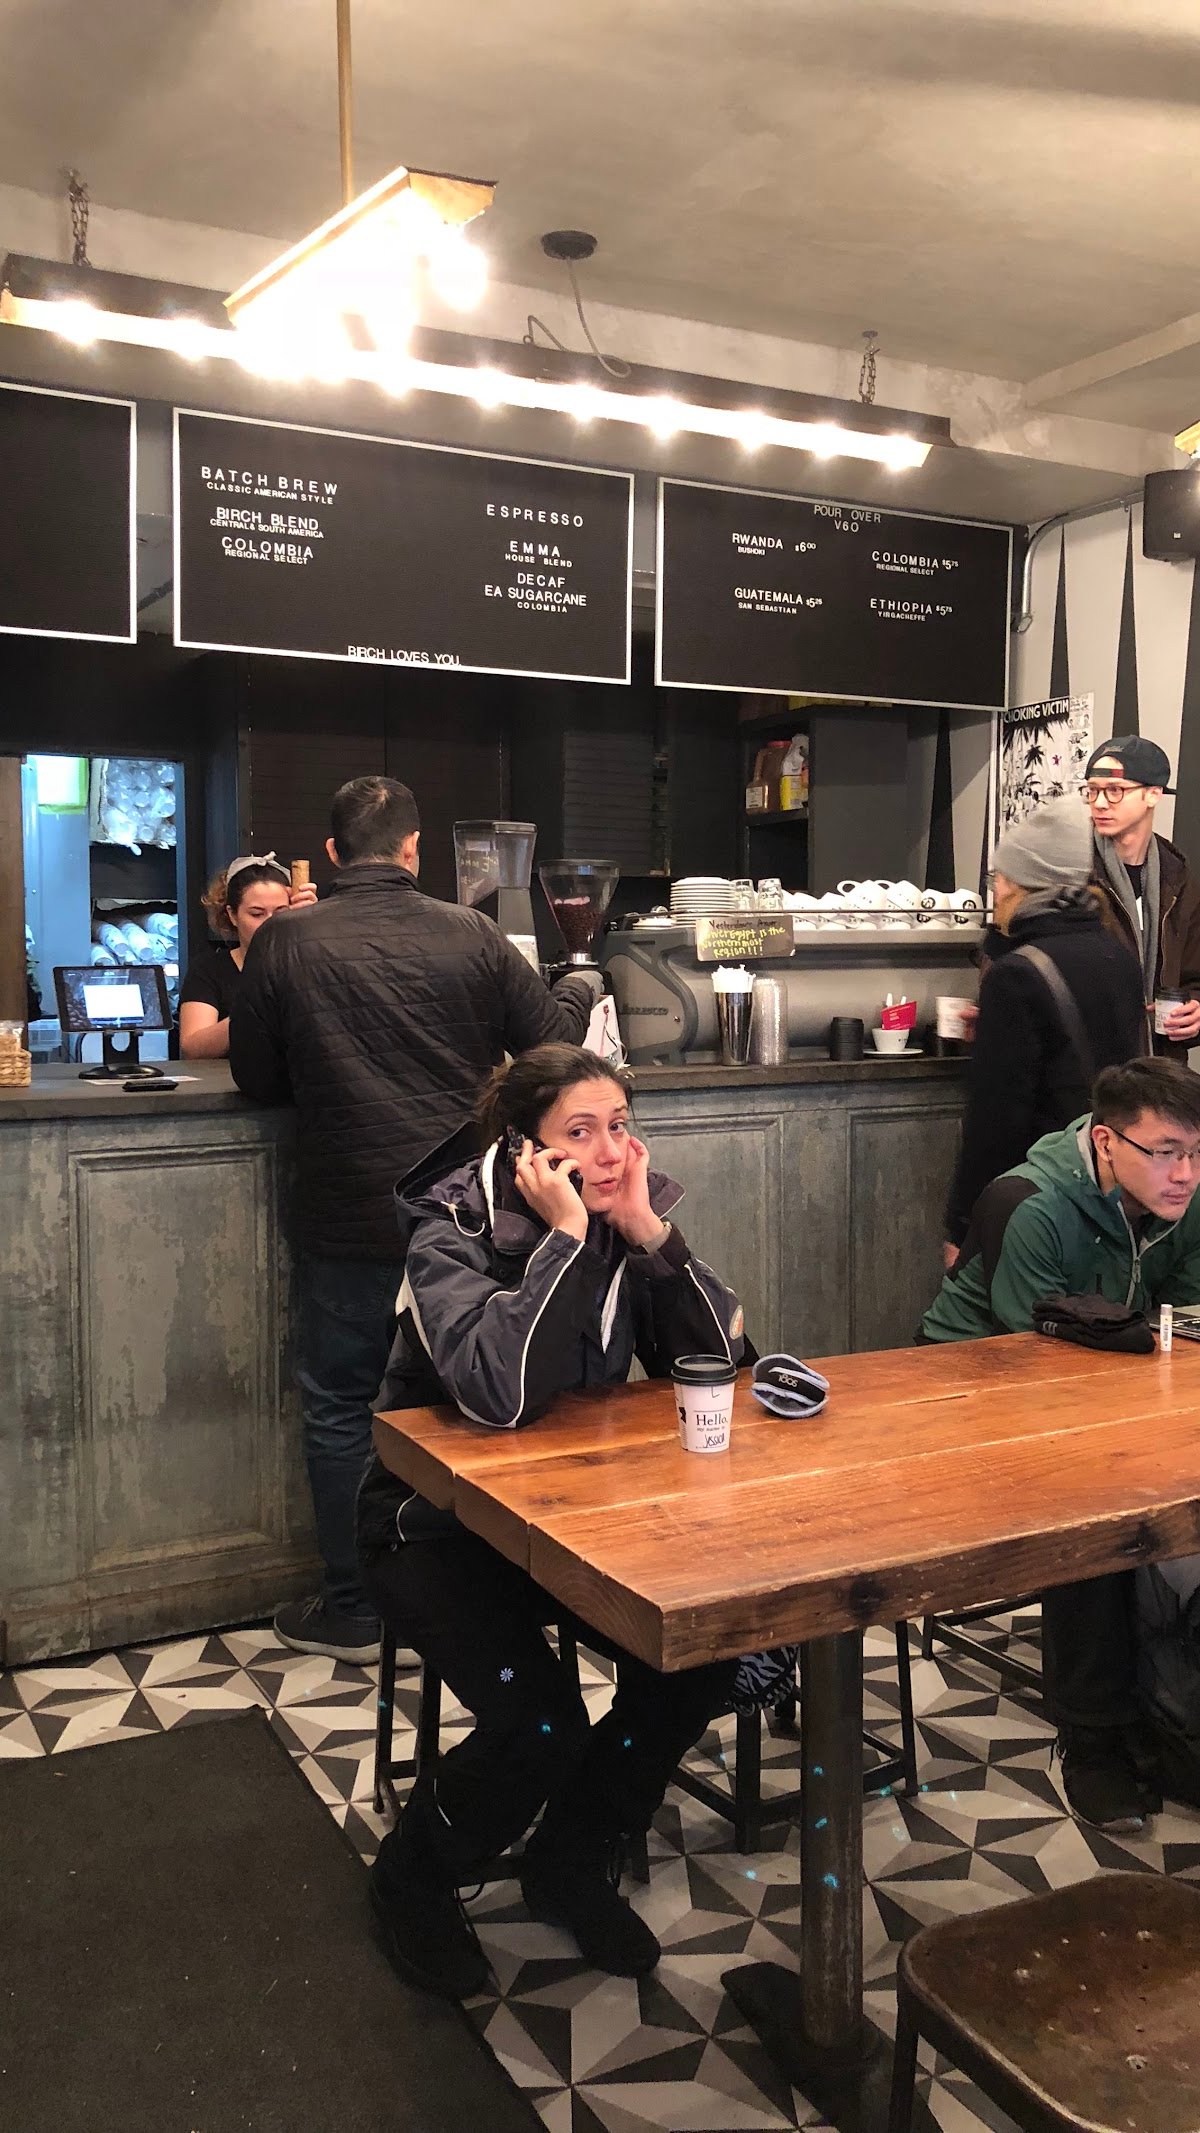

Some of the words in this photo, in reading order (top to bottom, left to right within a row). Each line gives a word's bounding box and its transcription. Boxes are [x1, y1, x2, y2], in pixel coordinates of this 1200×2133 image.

[201, 465, 268, 486] BATCH
[278, 476, 337, 495] BREW
[206, 481, 251, 494] CLASSIC
[253, 488, 297, 500] AMERICAN
[301, 493, 333, 505] STYLE
[216, 506, 262, 523] BIRCH
[270, 513, 319, 531] BLEND
[486, 504, 584, 528] ESPRESSO
[814, 504, 842, 518] POUR
[850, 509, 881, 523] OVER
[257, 524, 285, 534] SOUTH
[287, 527, 324, 539] AMERICA
[221, 536, 314, 558] COLOMBIA
[510, 540, 561, 557] EMMA
[732, 532, 784, 549] RWANDA
[225, 549, 270, 560] REGIONAL
[274, 555, 308, 565] SELECT
[737, 546, 765, 556] BUSHOKI
[872, 550, 939, 569] COLOMBIA
[505, 553, 535, 563] HOUSE
[543, 558, 573, 568] BLEND
[876, 563, 908, 573] REGIONAL
[910, 567, 934, 576] SELECT
[517, 572, 565, 588] DECAF
[484, 584, 503, 597] EA
[508, 586, 587, 606] SUGARCANE
[734, 587, 803, 605] GUATEMALA
[517, 601, 567, 613] COLOMBIA
[738, 602, 752, 610] SAN
[755, 604, 797, 614] SEBASTIAN
[870, 598, 932, 614] ETHIOPIA
[878, 611, 926, 622] YIRGACHEFFE
[347, 645, 385, 660] BIRCH
[390, 649, 429, 663] LOVES
[1004, 705, 1040, 723] CHOKING
[1042, 699, 1069, 716] VICTIM
[768, 926, 786, 936] the
